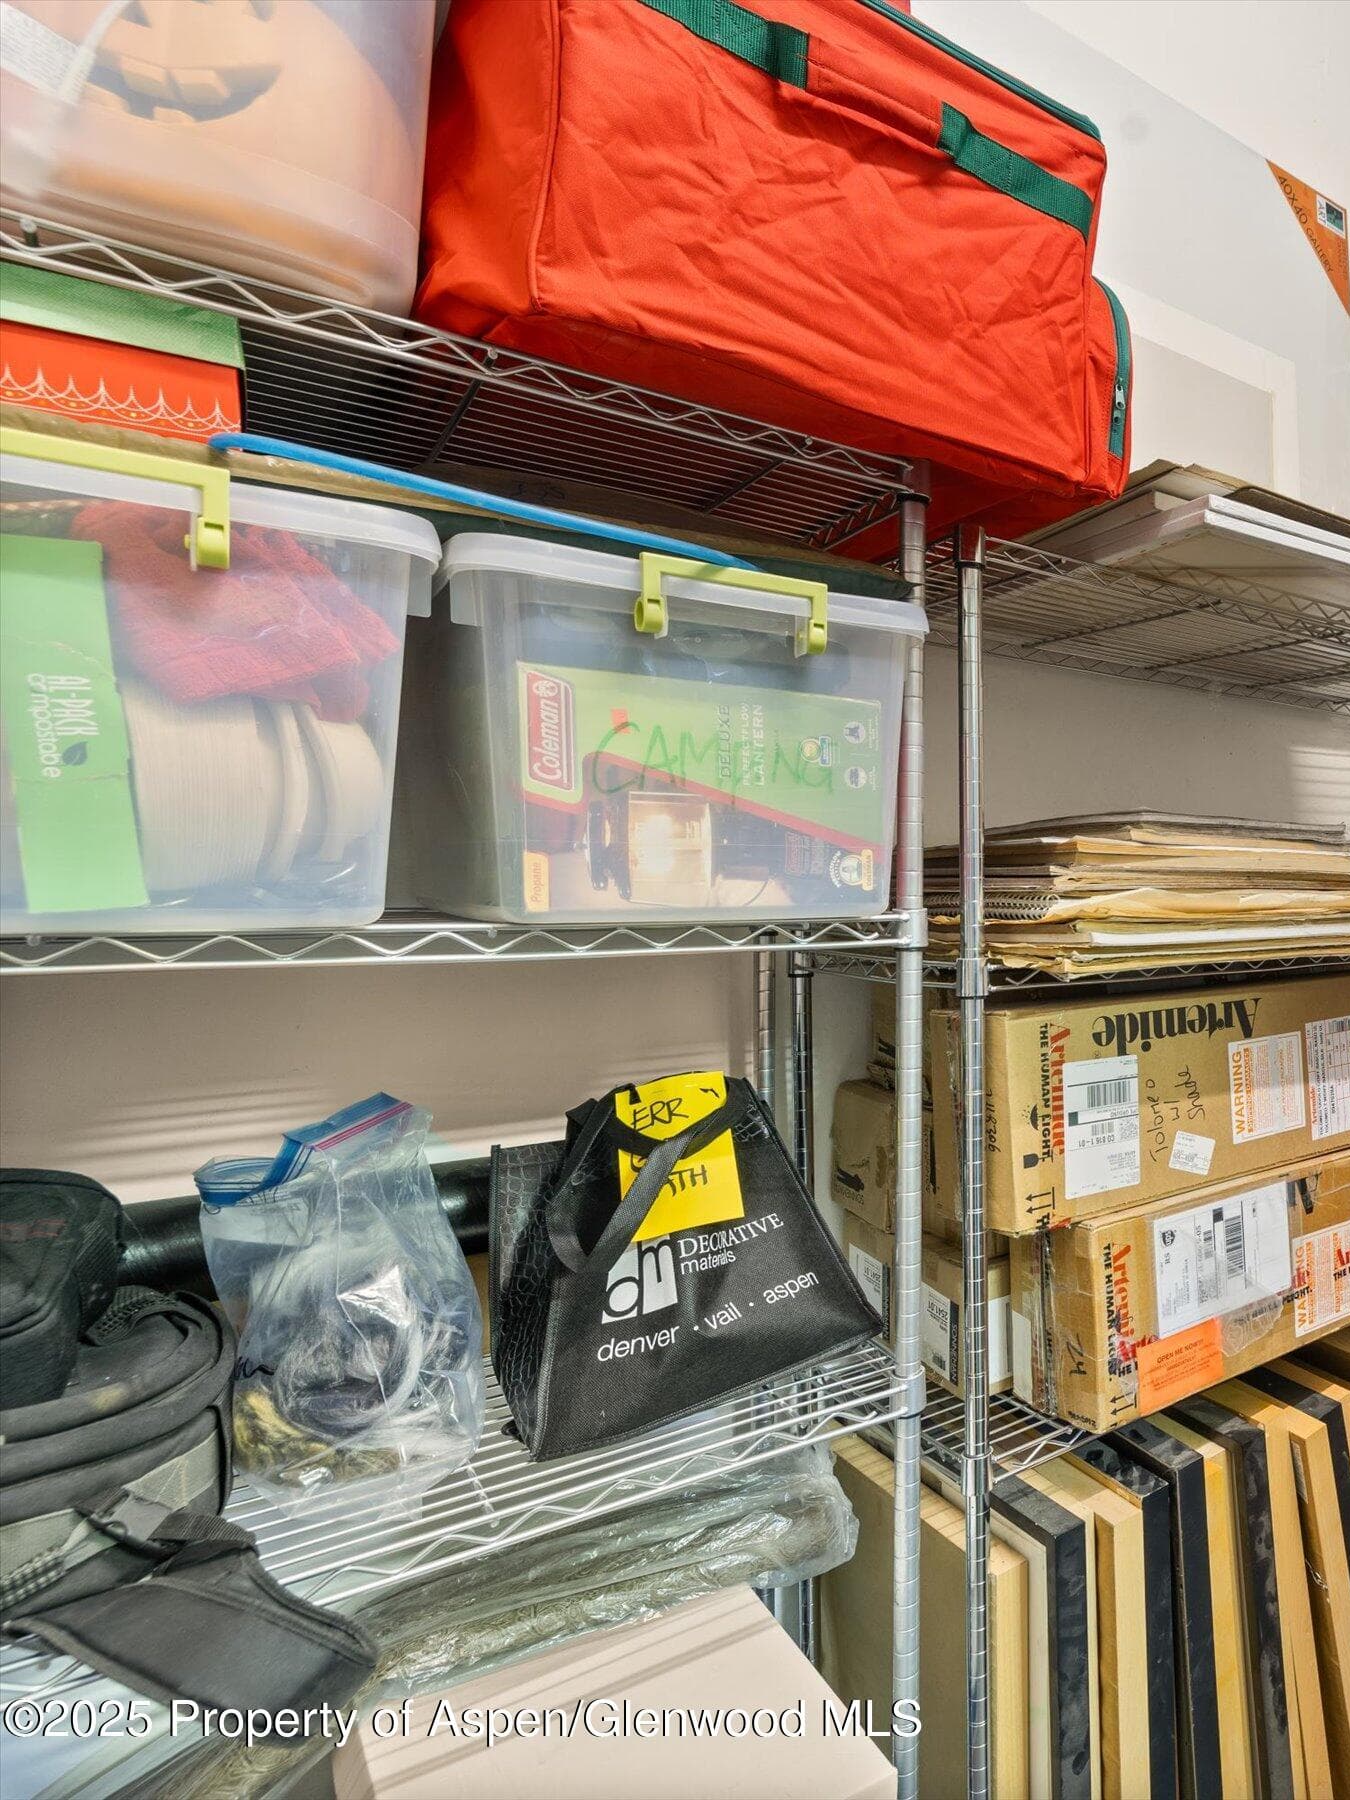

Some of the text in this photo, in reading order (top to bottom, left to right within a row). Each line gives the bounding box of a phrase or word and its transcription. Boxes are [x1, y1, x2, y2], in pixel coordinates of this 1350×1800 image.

[1306, 226, 1334, 273] GALLERY
[532, 700, 562, 781] Coleman
[718, 703, 732, 779] DELUXE
[752, 703, 767, 787] LANTERN
[530, 860, 543, 904] Propane
[1039, 1022, 1049, 1049] THE
[1092, 997, 1263, 1056] Artemide
[1040, 1052, 1051, 1108] HUMAN
[1231, 1051, 1247, 1135] WARNING
[630, 1098, 690, 1132] ERR
[677, 1212, 784, 1258] DECORATIVE
[1103, 1243, 1111, 1271] THE
[680, 1250, 737, 1275] materials
[1333, 1269, 1347, 1281] THE
[597, 1271, 819, 1362] denver vail aspen
[1104, 1273, 1117, 1331] HUMAN
[951, 1323, 959, 1382] SONNEMAN
[1156, 1350, 1174, 1364] OPEN
[1174, 1347, 1186, 1358] ME
